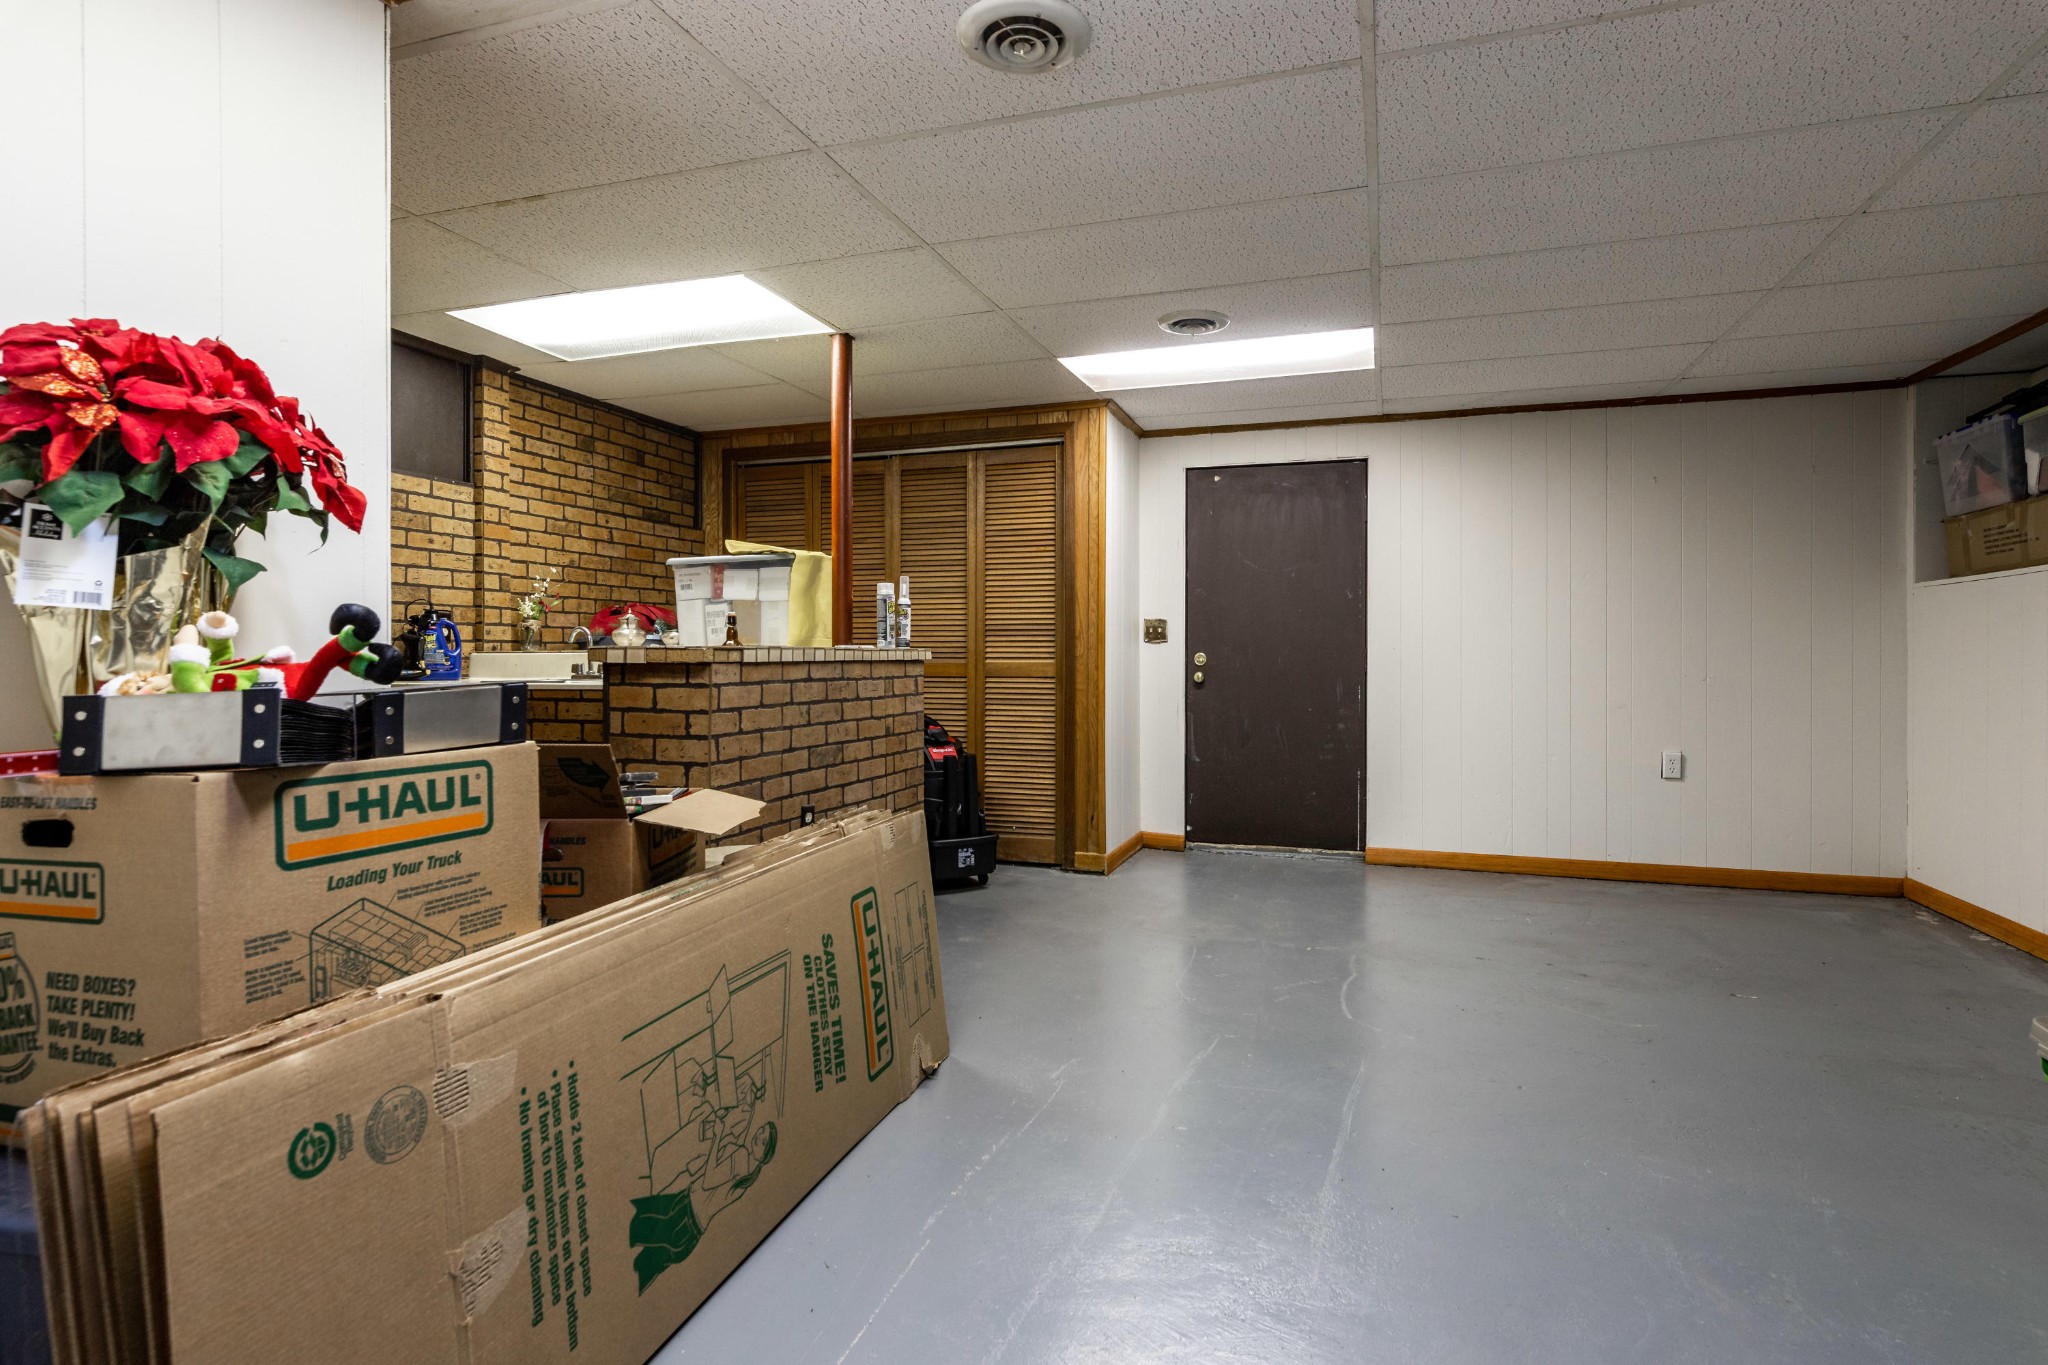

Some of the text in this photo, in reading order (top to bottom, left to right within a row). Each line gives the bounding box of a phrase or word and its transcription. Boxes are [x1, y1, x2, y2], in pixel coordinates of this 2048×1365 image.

[293, 774, 482, 833] U-HAUL
[326, 867, 388, 892] Loading
[392, 859, 424, 878] Your
[427, 850, 463, 871] Truck
[46, 971, 137, 997] NEED BOXES?
[862, 900, 889, 1063] U-HAUL
[47, 995, 136, 1021] TAKE PLENTY!
[803, 954, 824, 1093] ON THE HANGER
[813, 955, 833, 1076] CLOTHES STAY
[822, 933, 847, 1084] SAVES TIME!
[47, 1018, 146, 1047] We'll Buy Back
[47, 1042, 117, 1067] the Extras.
[519, 1099, 531, 1126] No
[550, 1081, 562, 1128] Place
[554, 1130, 567, 1189] smaller
[525, 1194, 536, 1213] or
[537, 1091, 561, 1307] of box to maximize space
[567, 1072, 592, 1297] Holds 2 feet of closet space
[526, 1216, 539, 1248] dry
[562, 1240, 572, 1262] on
[529, 1249, 545, 1328] cleaning
[564, 1261, 575, 1292] the
[566, 1290, 578, 1352] bottom
